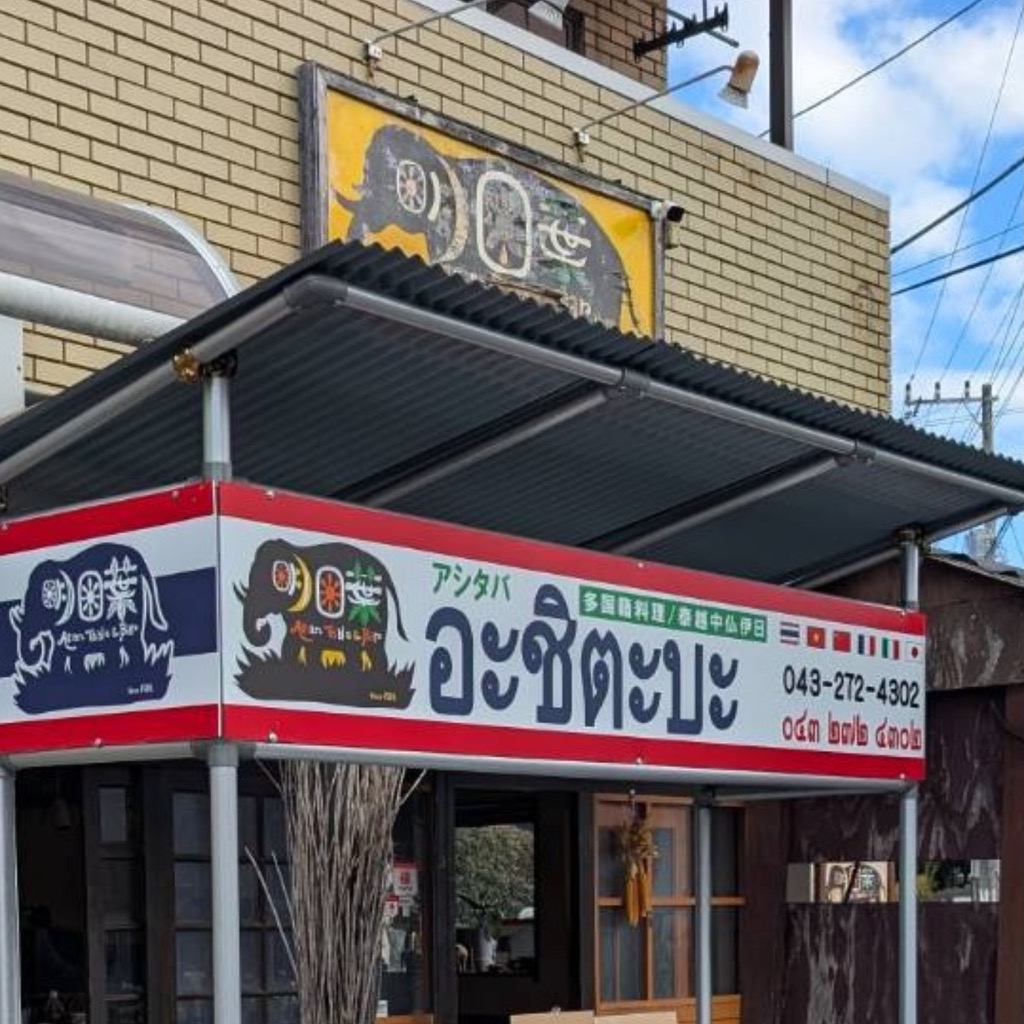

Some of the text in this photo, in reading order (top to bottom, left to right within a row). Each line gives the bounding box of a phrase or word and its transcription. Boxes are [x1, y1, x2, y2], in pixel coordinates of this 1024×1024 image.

[432, 561, 512, 601] アシタバ
[783, 665, 920, 708] 043-272-4302
